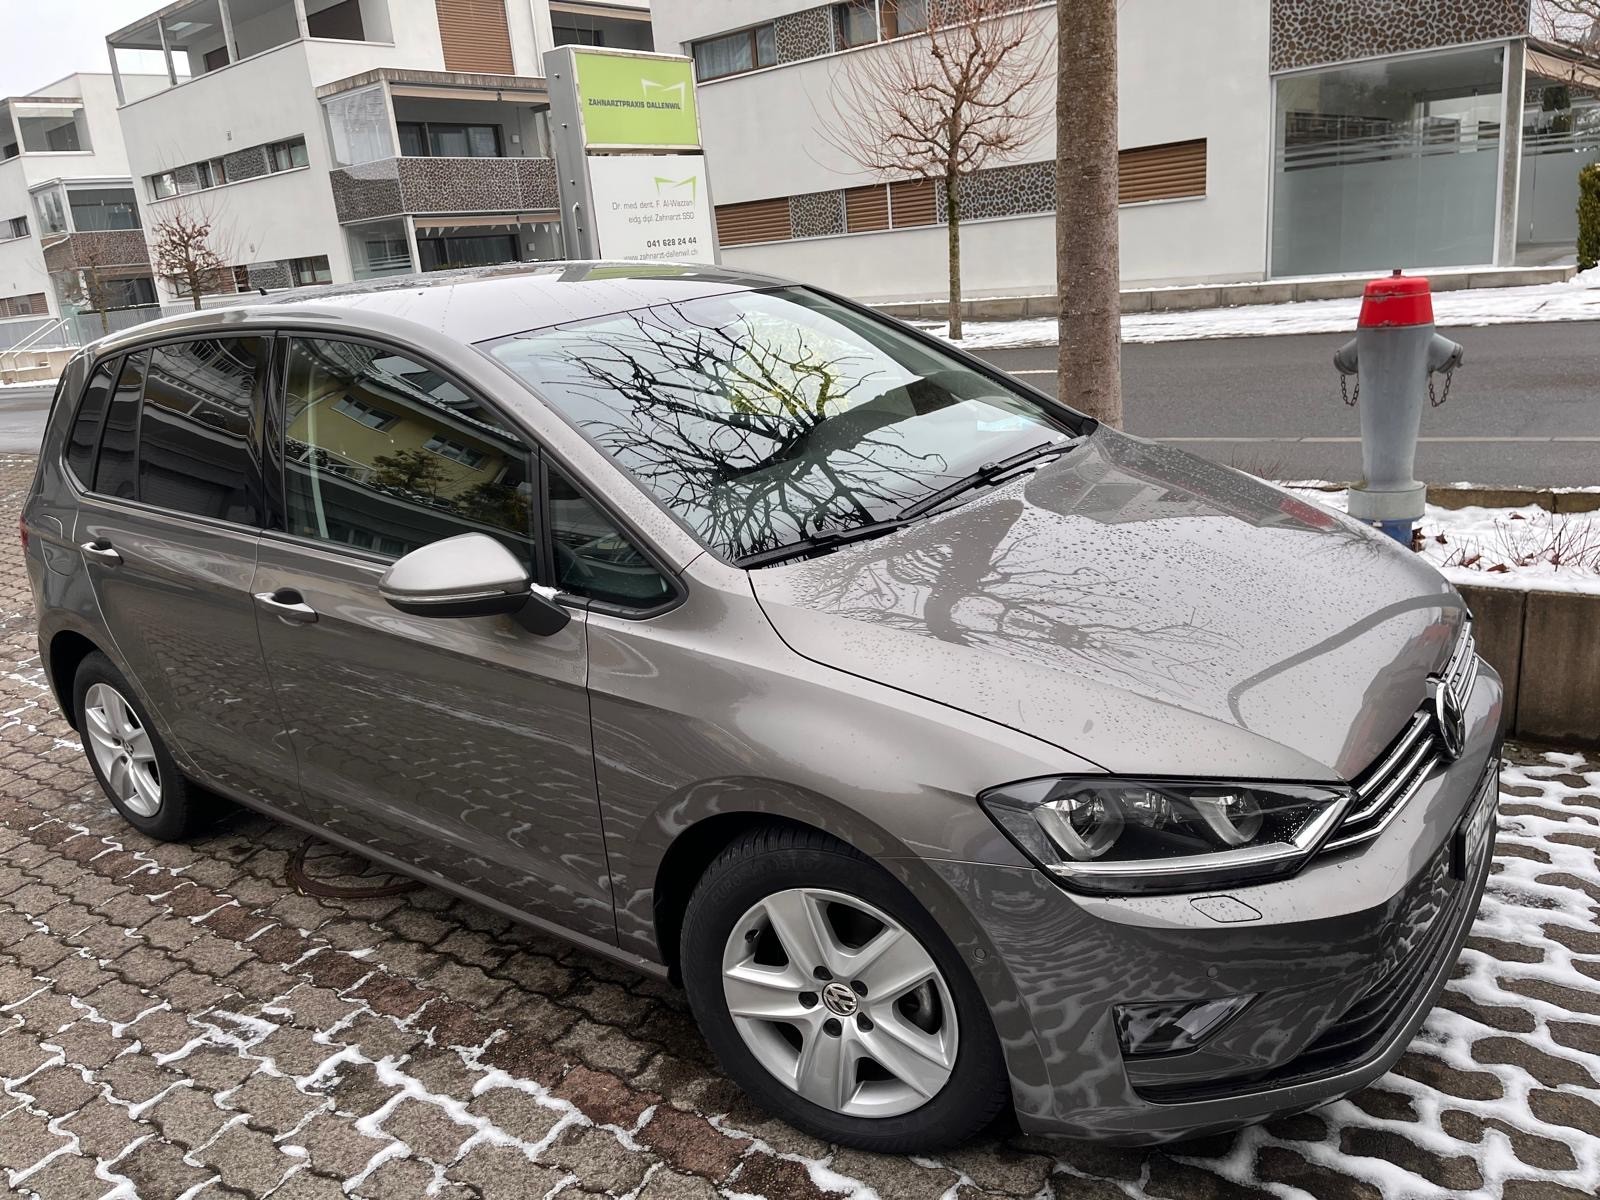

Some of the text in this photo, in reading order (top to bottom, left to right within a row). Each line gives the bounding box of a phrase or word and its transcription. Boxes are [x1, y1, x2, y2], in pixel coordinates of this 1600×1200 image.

[588, 98, 681, 110] ZAHNARZTPRAXIS DALLENWIL
[611, 201, 622, 210] Dr.
[655, 213, 682, 222] Zahnarzt
[646, 236, 697, 248] 041 628 24 44
